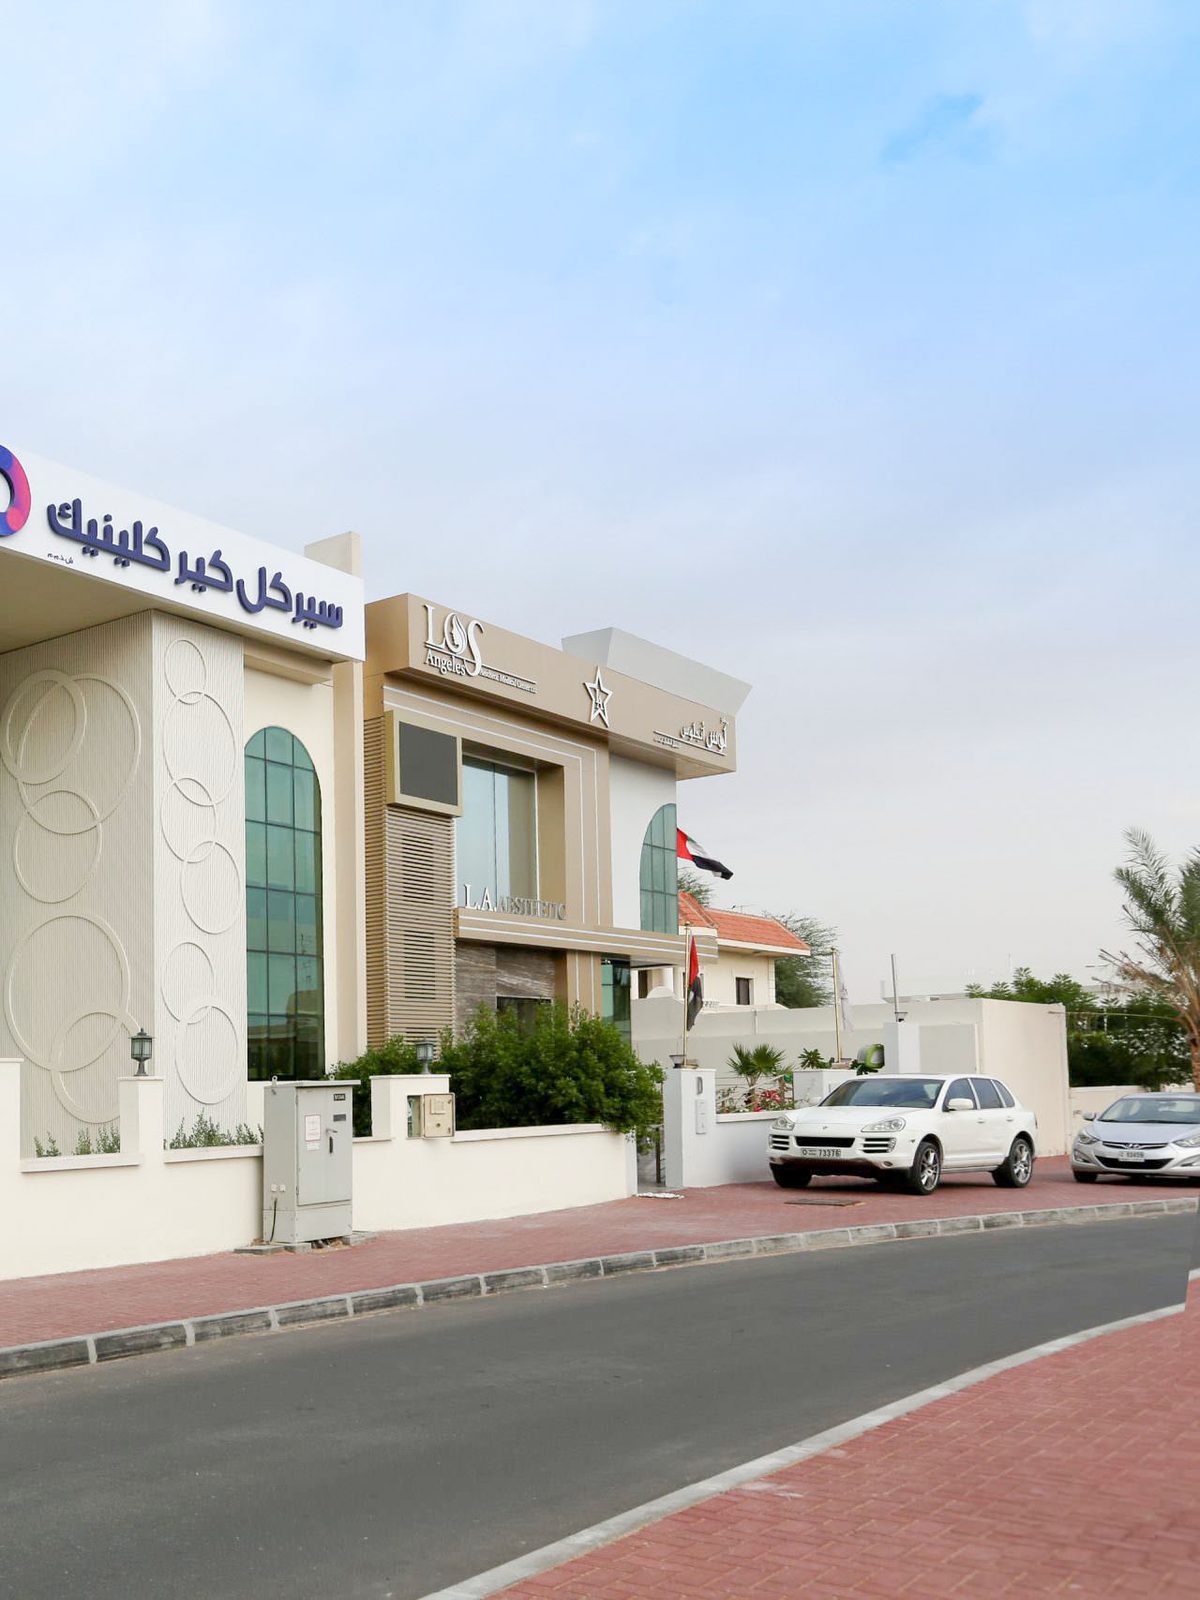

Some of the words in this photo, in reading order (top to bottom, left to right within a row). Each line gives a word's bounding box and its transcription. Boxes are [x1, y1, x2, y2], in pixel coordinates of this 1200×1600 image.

[47, 498, 171, 572] كلينيك
[173, 549, 234, 594] كير
[236, 566, 343, 631] سيركل
[423, 604, 484, 677] LOS
[424, 648, 467, 676] Angeles
[463, 883, 497, 912] L.A.
